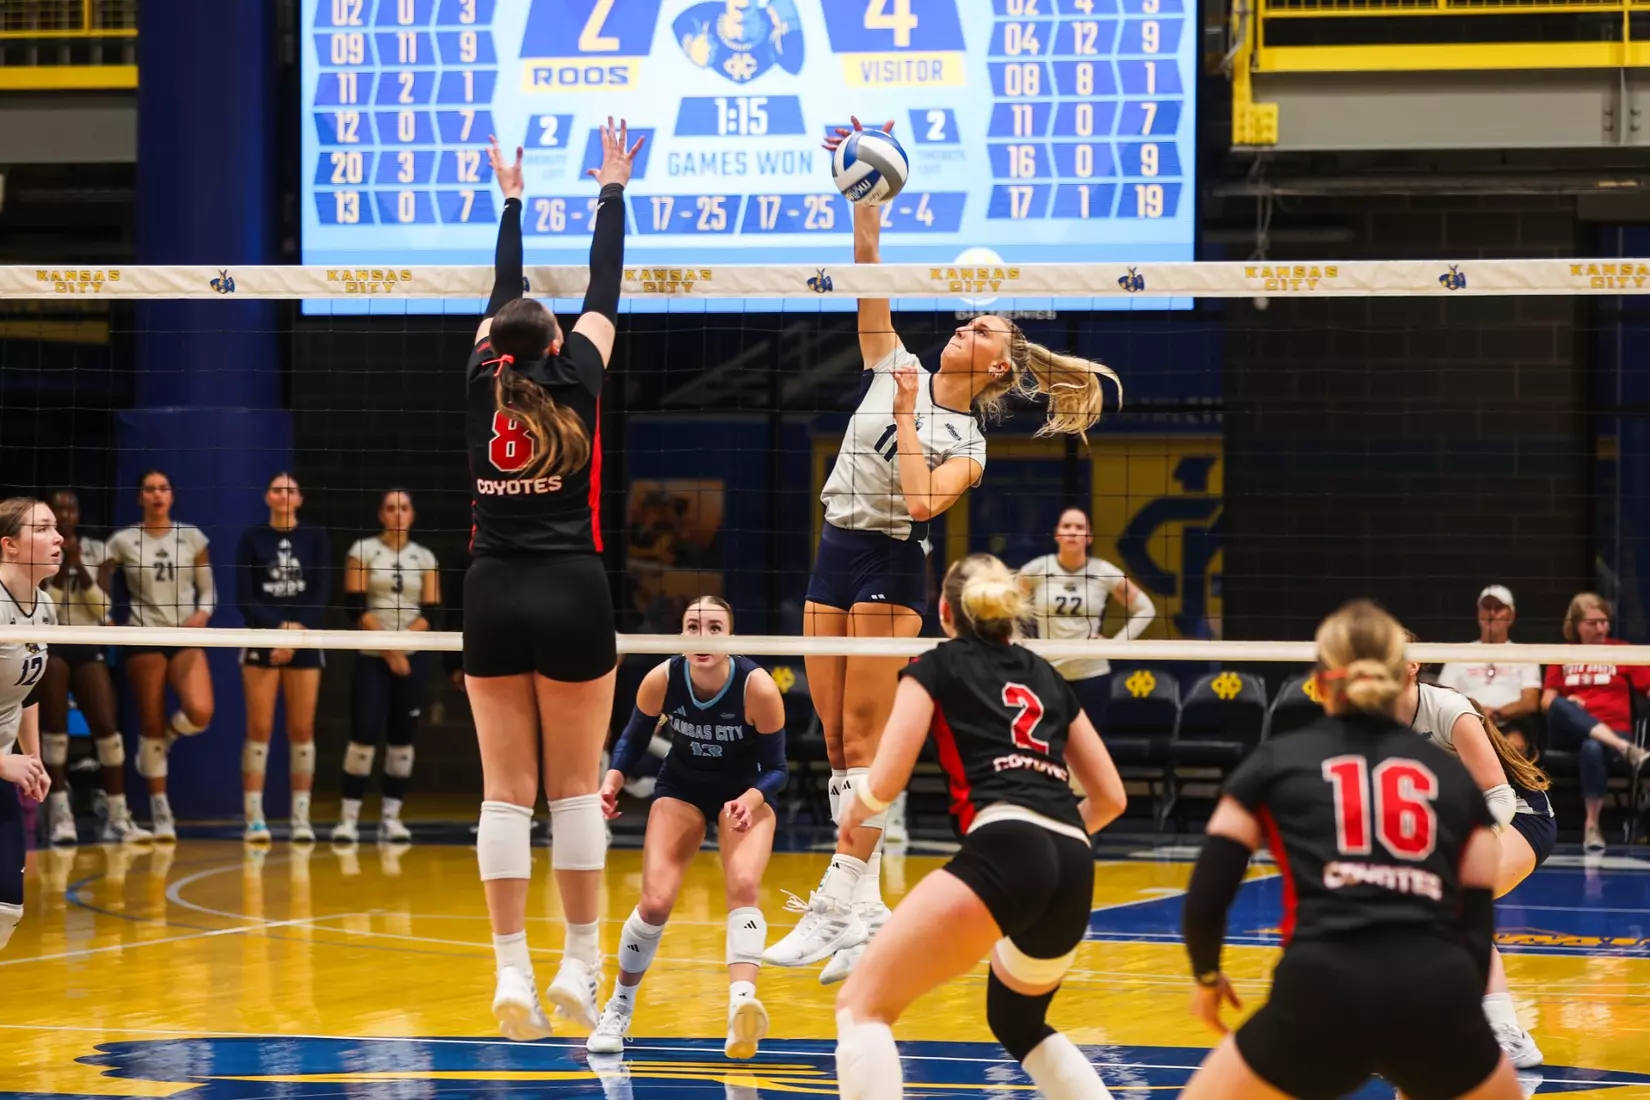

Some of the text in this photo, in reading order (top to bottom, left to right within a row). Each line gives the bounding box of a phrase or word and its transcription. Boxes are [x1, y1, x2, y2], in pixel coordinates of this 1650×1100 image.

[332, 0, 363, 26] 02
[332, 30, 477, 64] 09 11 9
[1004, 20, 1160, 56] 04 12 9
[532, 66, 629, 86] ROOS
[861, 59, 943, 82] VISITOR
[1005, 62, 1156, 96] 08 8 1
[336, 70, 474, 104] 11 2 1
[335, 109, 475, 142] 12 0 7
[714, 97, 768, 136] 1:15
[926, 110, 946, 140] 2
[1011, 102, 1157, 137] 11 0 7
[539, 115, 558, 146] 2
[330, 150, 480, 184] 20 3 12
[667, 151, 812, 176] GAMES WON
[1007, 144, 1158, 179] 16 0 9
[334, 190, 475, 224] 13 0 7
[1008, 184, 1164, 218] 17 1 19
[36, 270, 120, 282] KANSAS
[327, 270, 412, 282] KANSAS
[624, 269, 712, 282] KANSAS
[930, 268, 1020, 280] KANSAS
[1245, 266, 1338, 278] KANSAS
[1264, 278, 1320, 291] CITY
[1590, 276, 1648, 289] CITY
[54, 282, 105, 294] CITY
[345, 282, 396, 294] CITY
[643, 282, 694, 294] CITY
[948, 280, 1002, 292] CITY
[489, 409, 536, 472] 8
[477, 475, 562, 496] COYOTES
[154, 562, 174, 582] 21
[391, 573, 404, 594] 3
[1056, 596, 1082, 615] 22
[13, 656, 43, 686] 12
[1002, 682, 1049, 755] 2
[716, 724, 744, 742] CITY
[1321, 754, 1439, 861] 16
